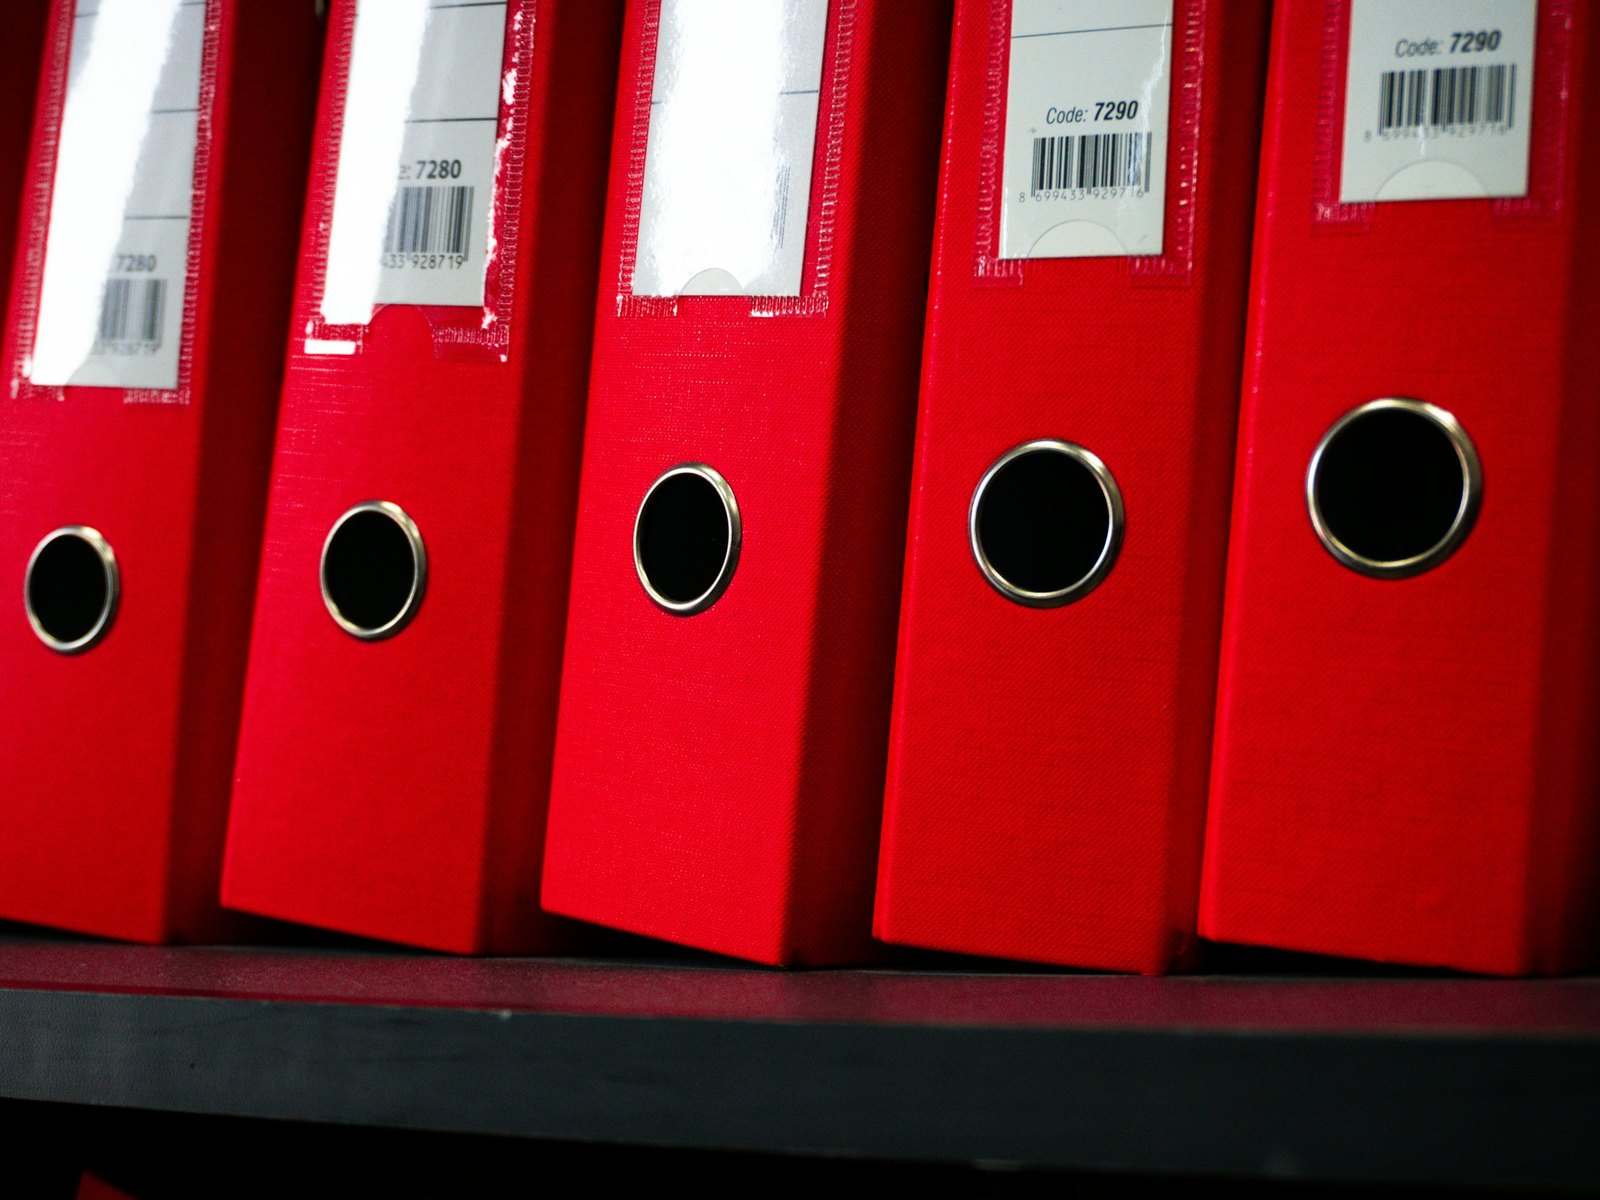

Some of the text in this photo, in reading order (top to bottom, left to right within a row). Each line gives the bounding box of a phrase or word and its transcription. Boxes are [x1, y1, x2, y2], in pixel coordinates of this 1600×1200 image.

[1449, 29, 1502, 53] 7290
[1046, 100, 1139, 125] Code: 7290
[415, 159, 462, 179] 7280
[1018, 191, 1026, 203] 8
[1035, 189, 1085, 202] 699433
[115, 254, 157, 272] 7280
[411, 254, 464, 269] 928719
